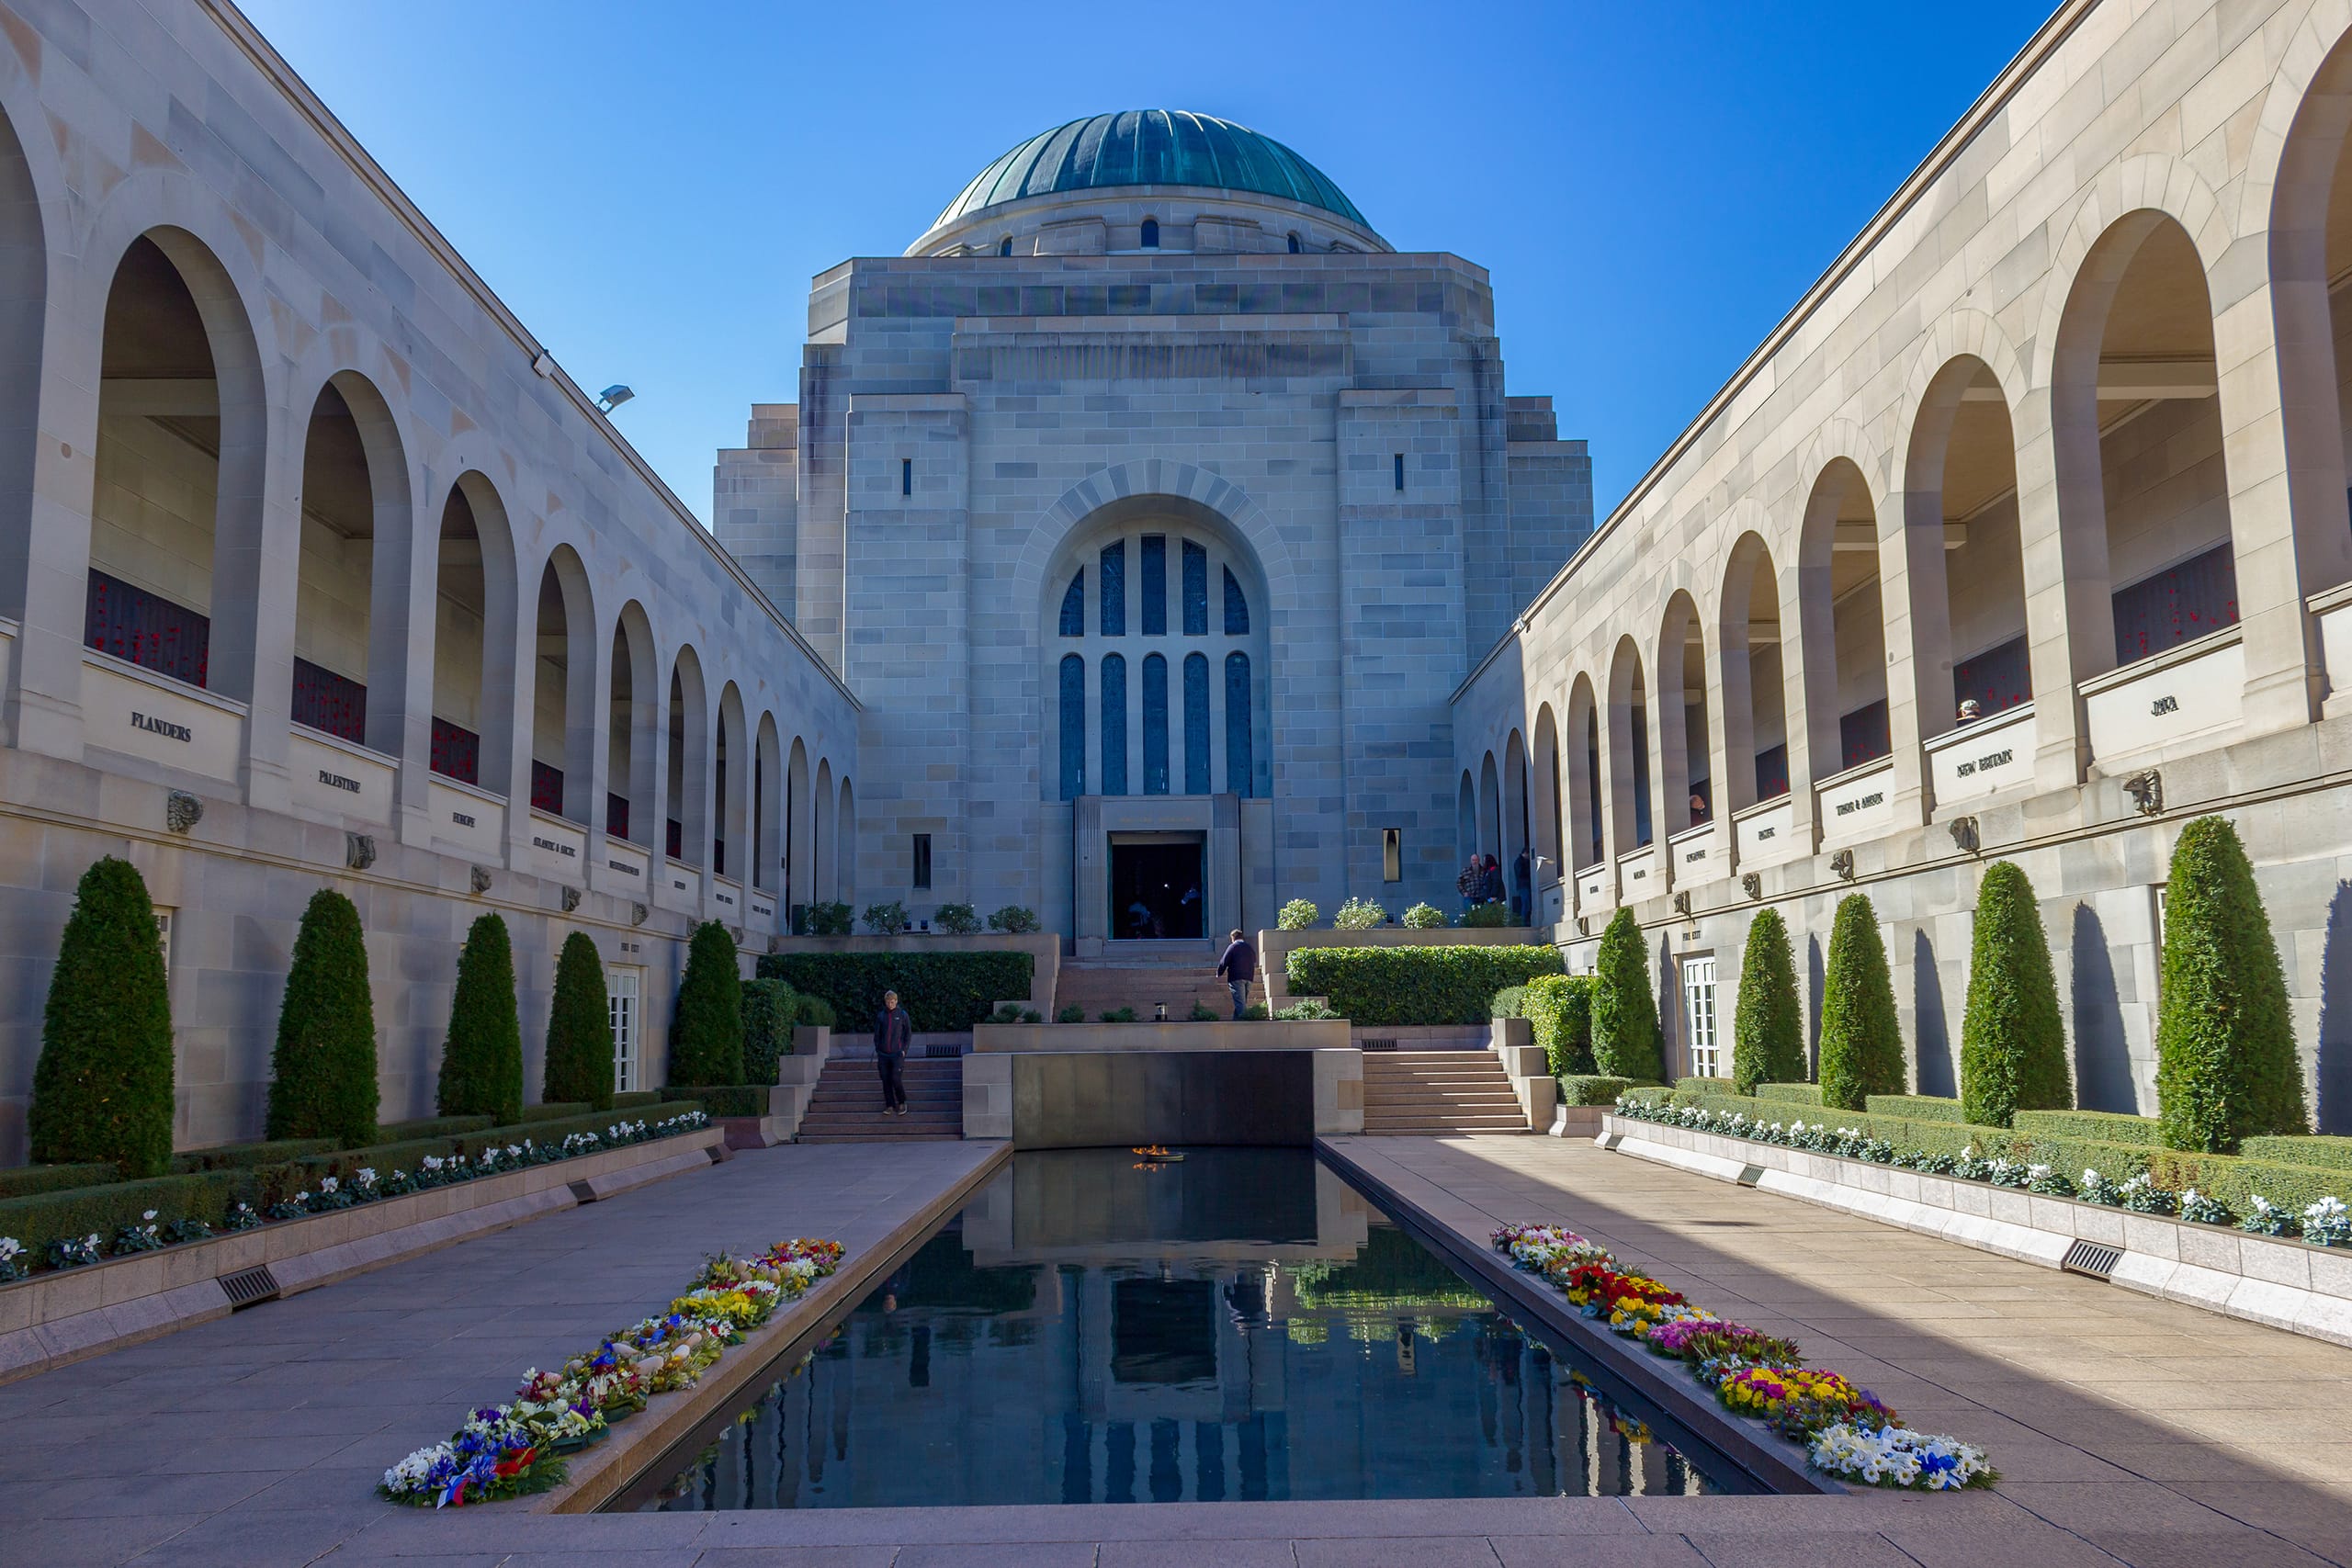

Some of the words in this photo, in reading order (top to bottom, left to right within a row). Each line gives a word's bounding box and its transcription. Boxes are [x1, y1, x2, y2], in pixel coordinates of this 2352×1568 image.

[2151, 695, 2179, 716] JAVA
[131, 711, 191, 743] FLANDERS
[1957, 761, 1976, 778] NEW
[1978, 749, 2013, 772] BRITAIN
[319, 770, 361, 794] PALESTINE
